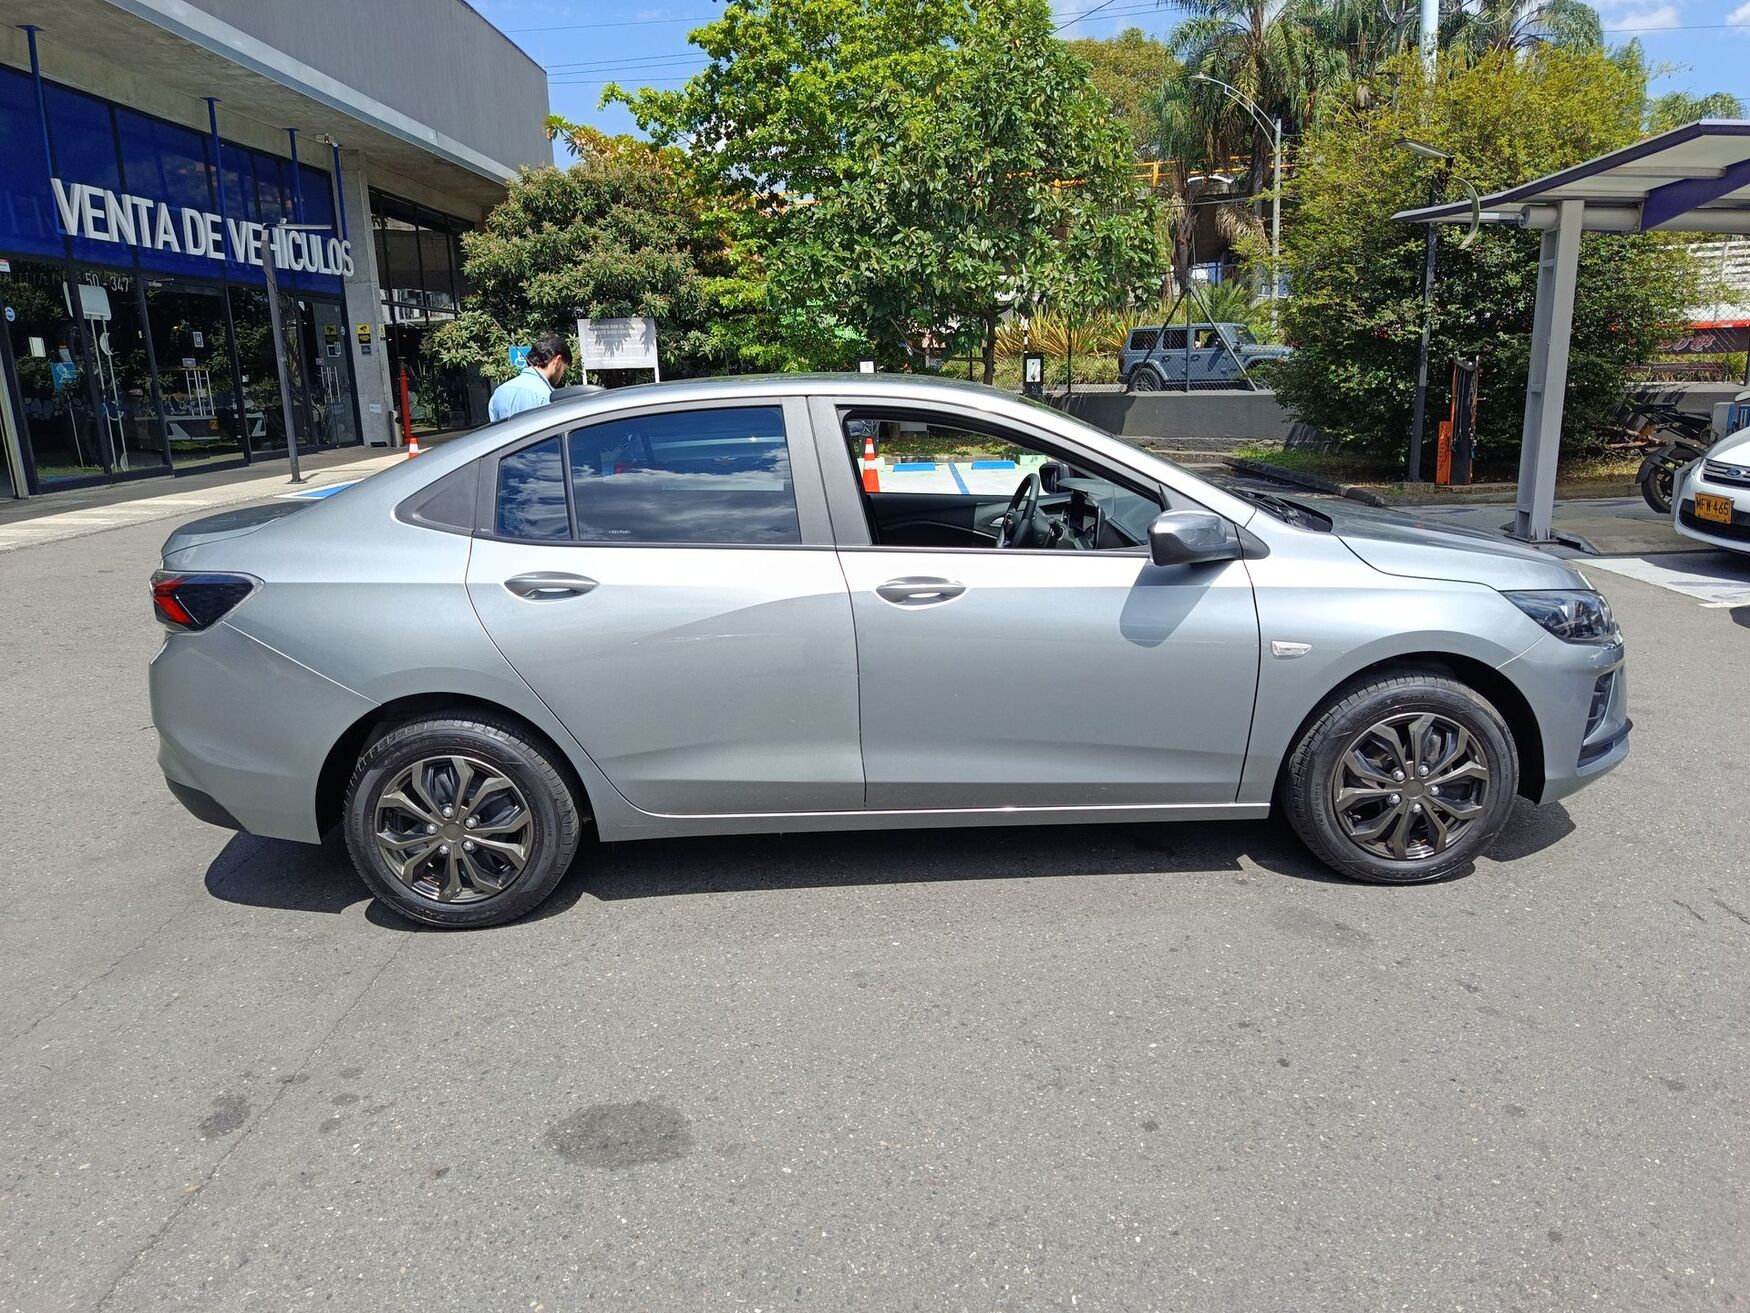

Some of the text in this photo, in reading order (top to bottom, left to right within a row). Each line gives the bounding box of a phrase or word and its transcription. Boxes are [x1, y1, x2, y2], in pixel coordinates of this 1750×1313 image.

[50, 178, 181, 253] VENTA
[181, 207, 226, 260] DE
[110, 275, 129, 293] 347
[1713, 501, 1729, 516] 465
